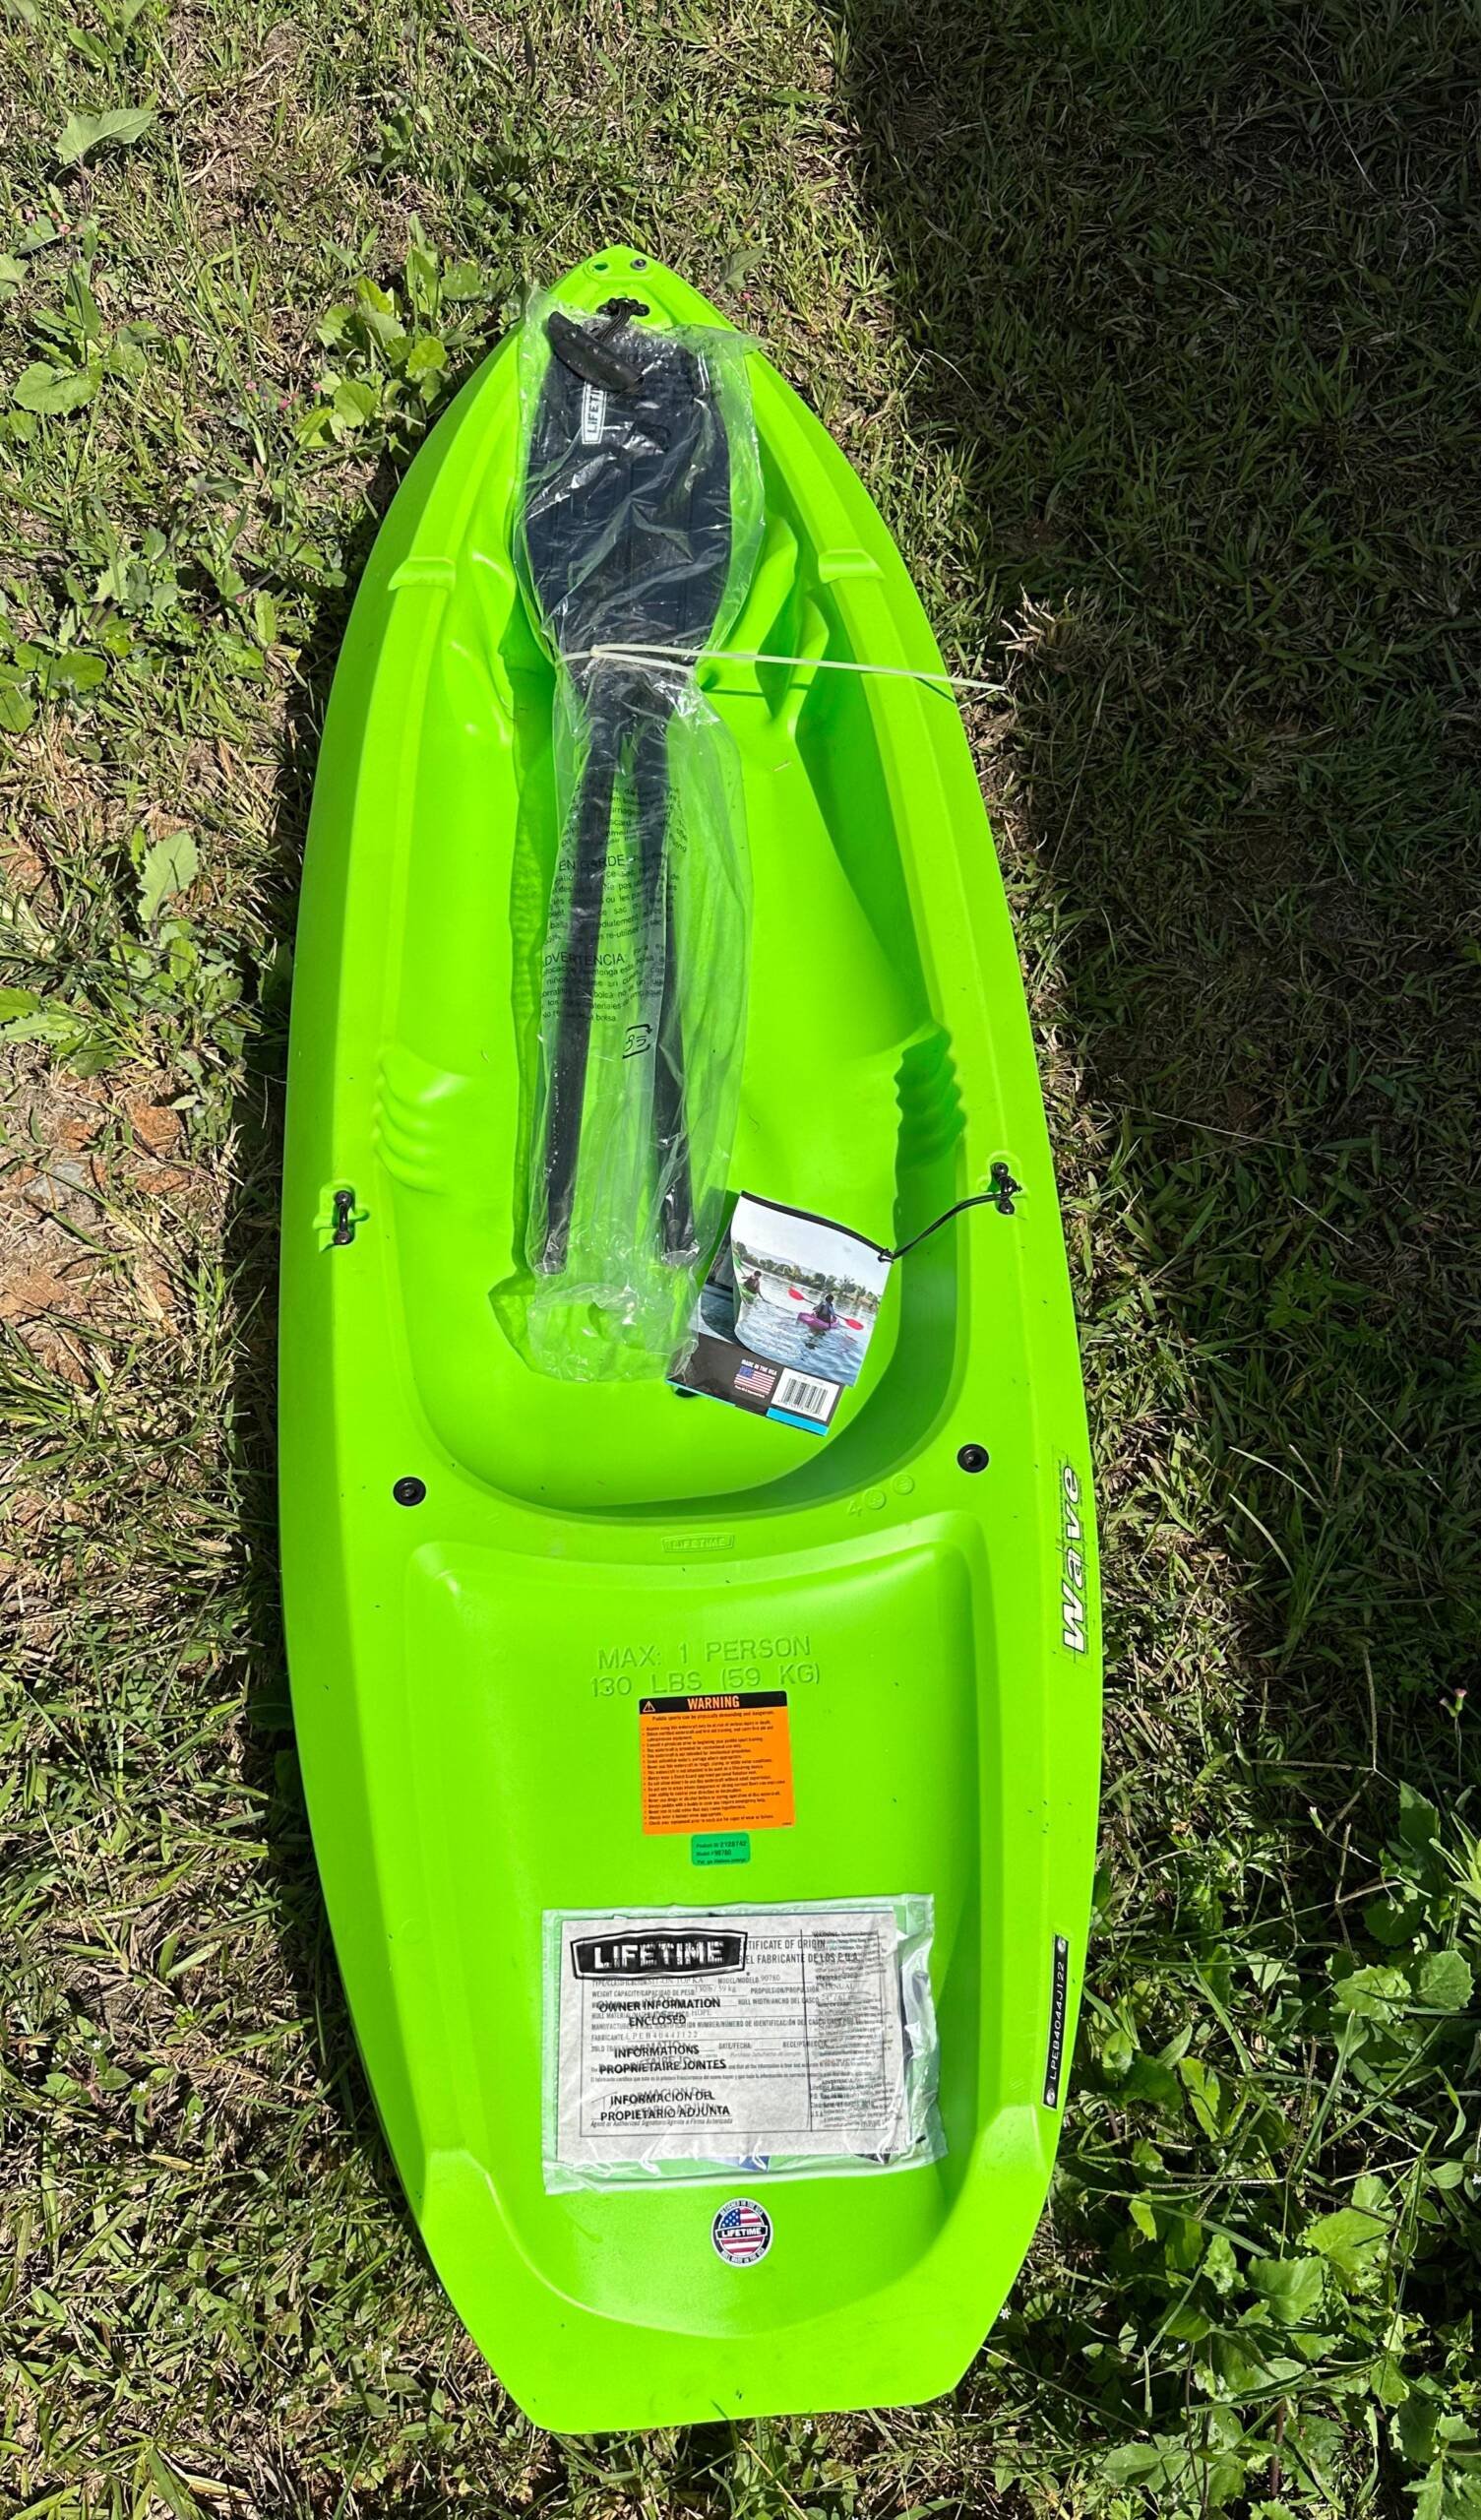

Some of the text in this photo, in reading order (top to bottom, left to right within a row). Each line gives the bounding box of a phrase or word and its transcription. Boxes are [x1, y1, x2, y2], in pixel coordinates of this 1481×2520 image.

[586, 386, 600, 433] LIFETI
[559, 859, 576, 871] EN
[1062, 1465, 1085, 1654] Wave
[597, 1635, 811, 1670] MAX: 1 PERSON
[591, 1663, 821, 1698] 130 LBS (59 KG)
[687, 1695, 740, 1711] WARNING
[747, 1938, 783, 1951] TIFICATE
[784, 1938, 795, 1950] OF
[593, 1940, 725, 1970] LIFETIME
[757, 1953, 804, 1965] FABRICANTE
[598, 2000, 642, 2013] OWNER
[643, 1997, 721, 2011] INFORMATION
[628, 2014, 687, 2028] ENCLOSED
[614, 2045, 701, 2059] INFORMATIONS
[598, 2061, 680, 2075] PROPRIETAIRE
[682, 2058, 727, 2071] JOINTES
[610, 2090, 715, 2106] INFORMACION DEL
[600, 2105, 731, 2121] PROPIETARIO ADJUNTA
[721, 2227, 762, 2237] LIFETIME
